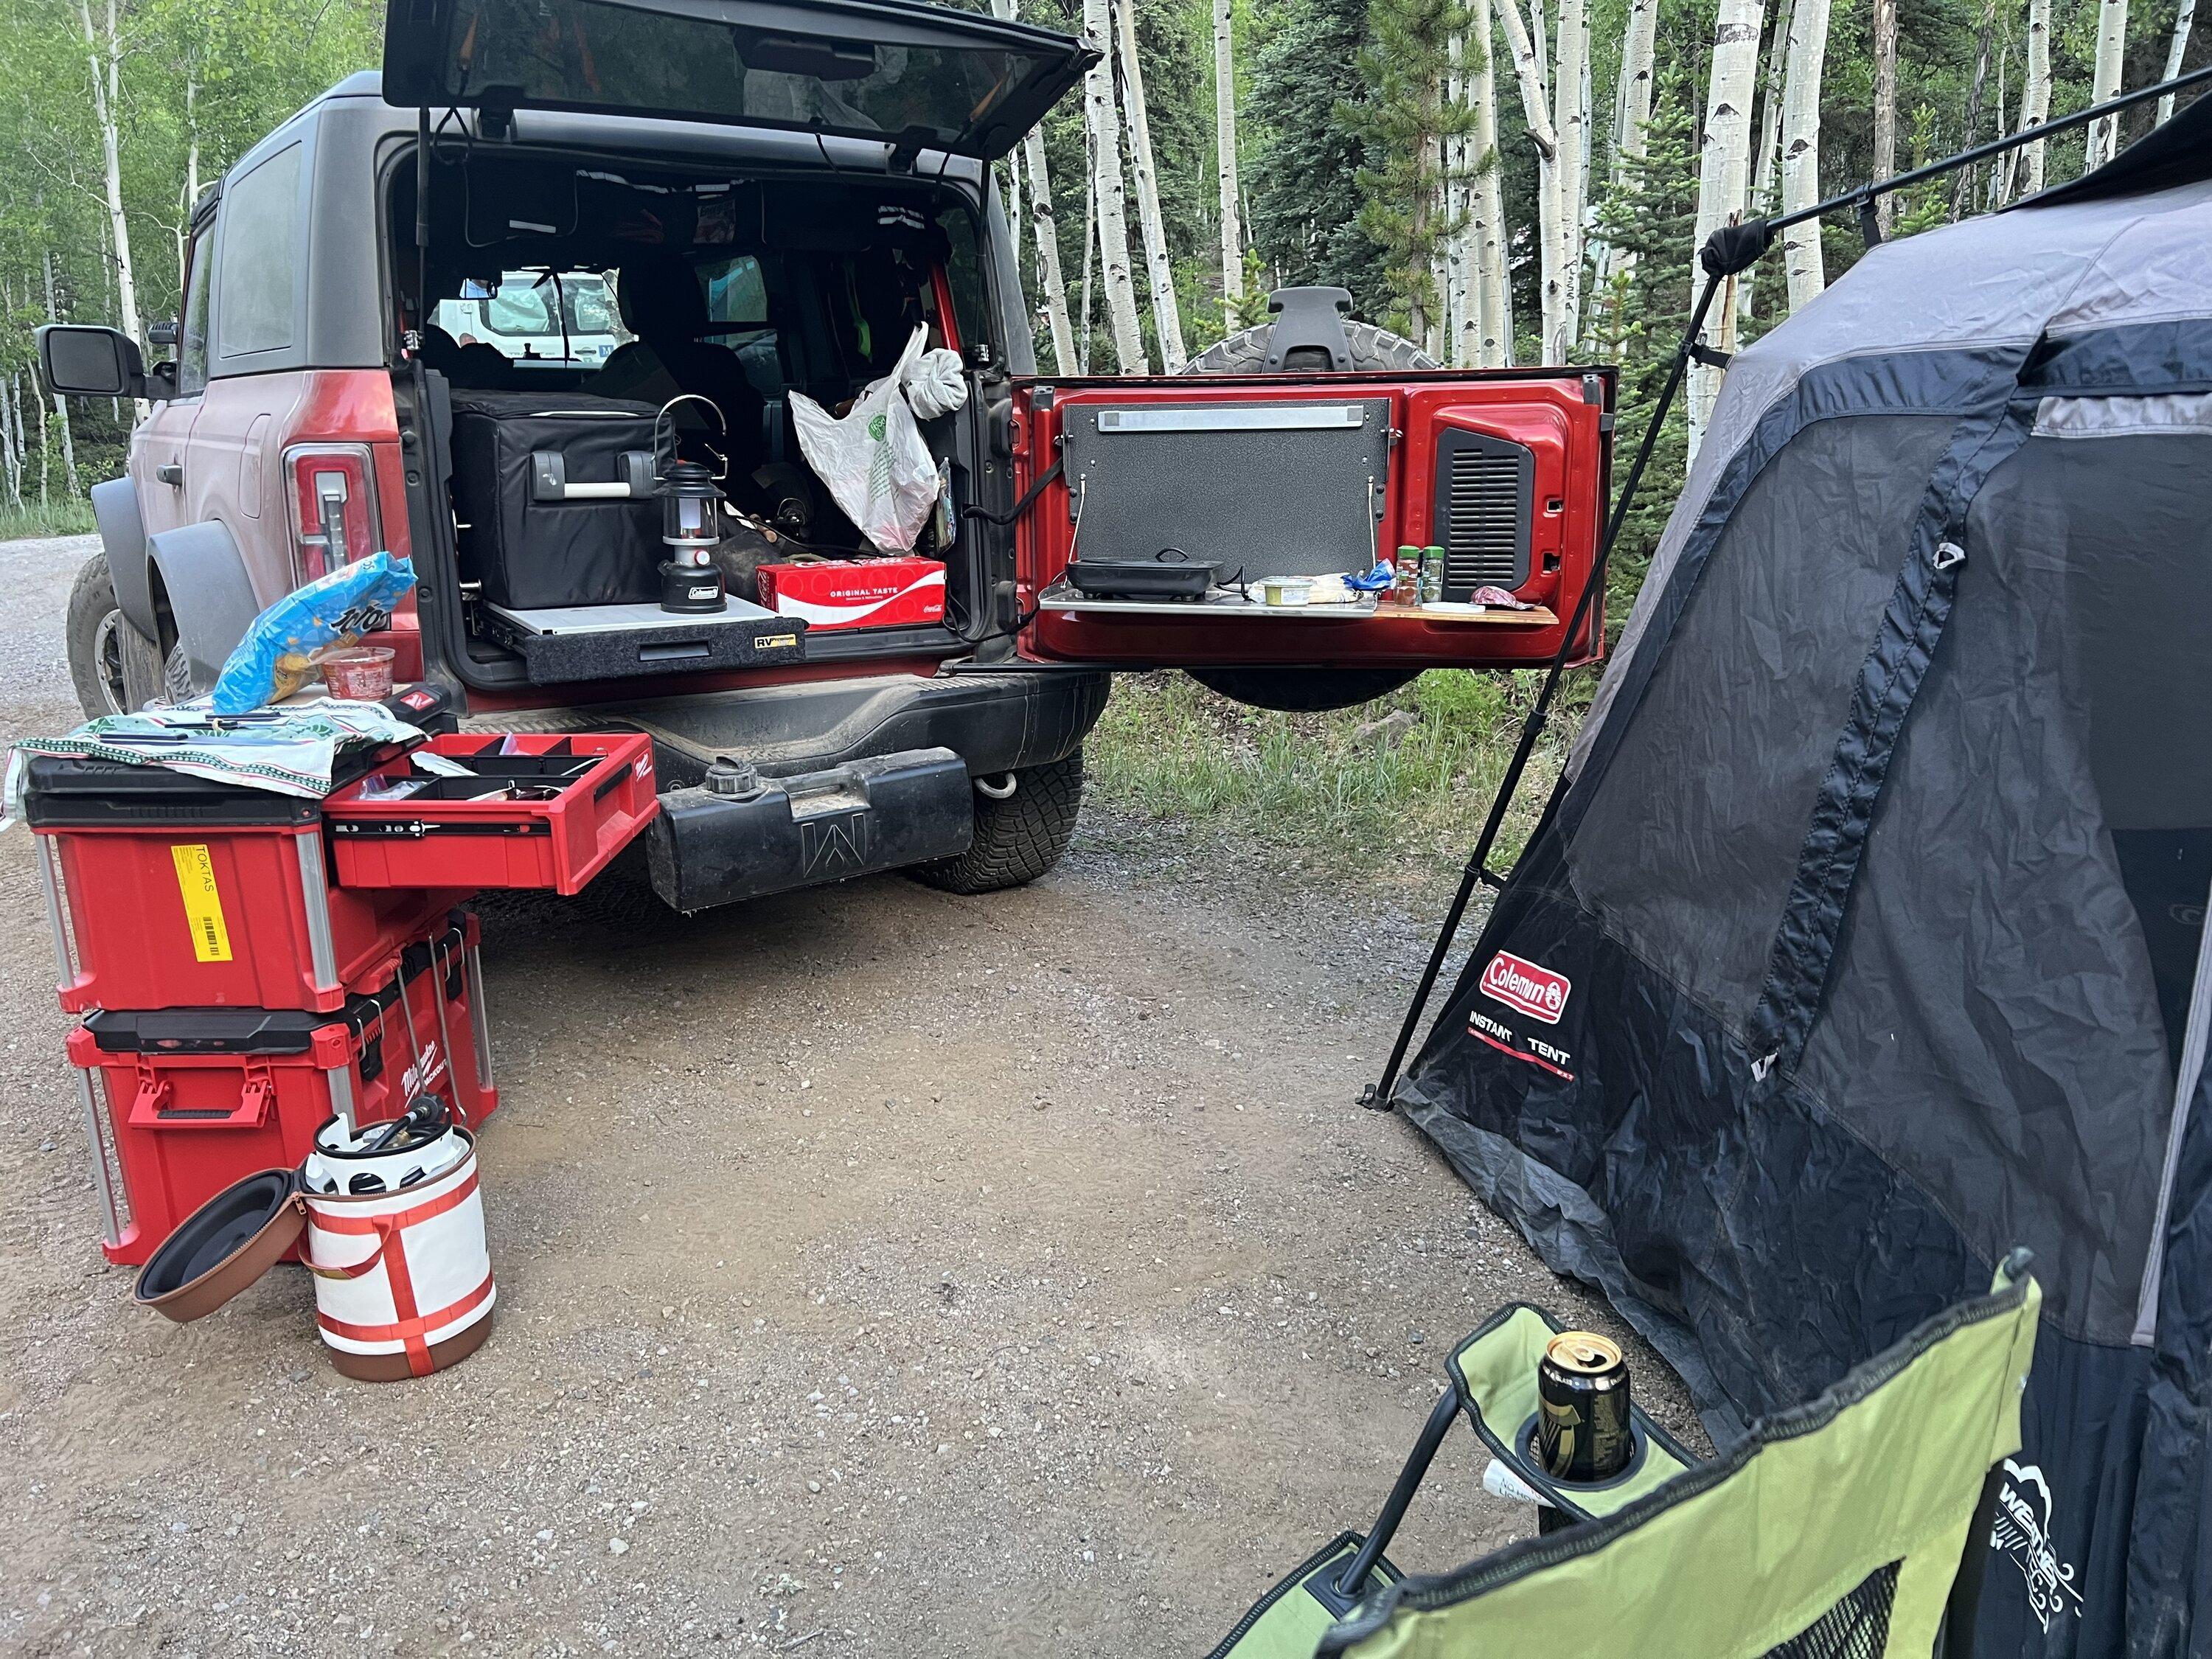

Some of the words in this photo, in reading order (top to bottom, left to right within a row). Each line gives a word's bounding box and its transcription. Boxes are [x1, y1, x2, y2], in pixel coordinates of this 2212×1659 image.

[830, 589, 871, 598] ORIGINAL
[757, 638, 772, 647] RV
[195, 846, 214, 892] TOKTAS
[1470, 1010, 1512, 1042] INSTANT
[1528, 1037, 1571, 1065] TENT
[401, 1040, 436, 1097] Milaukee
[1501, 1478, 1514, 1492] NO
